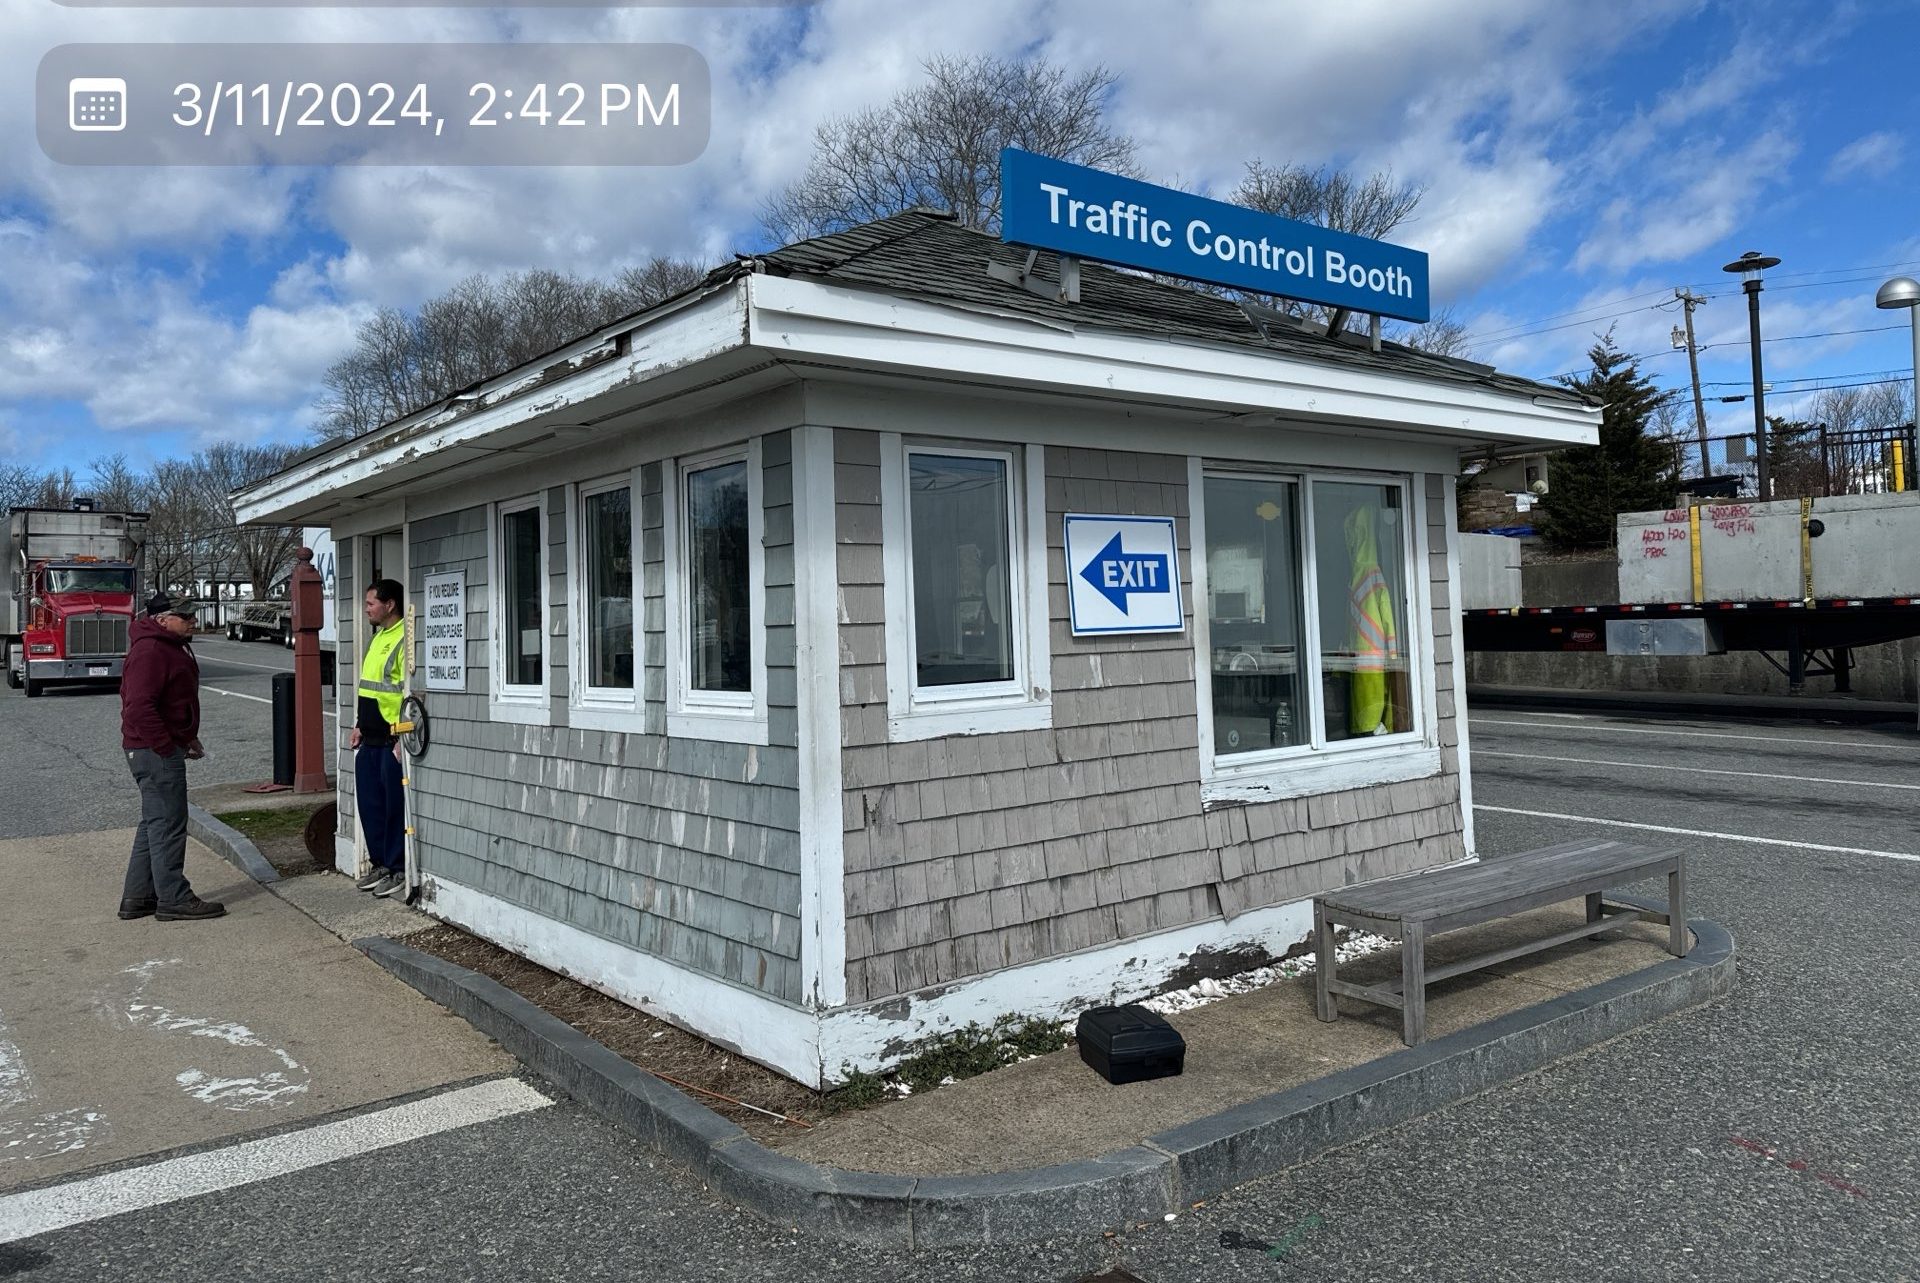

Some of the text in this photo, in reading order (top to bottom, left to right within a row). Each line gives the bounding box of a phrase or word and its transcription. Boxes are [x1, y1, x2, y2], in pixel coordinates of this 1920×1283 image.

[1040, 183, 1413, 298] Traffic Control Booth
[1102, 560, 1159, 588] EXIT
[433, 584, 441, 599] YOU
[441, 582, 459, 598] REQUIRE
[430, 603, 459, 618] ASSISTANCE IN
[427, 623, 463, 639] BOARDING PLEASE
[440, 645, 448, 659] FOR
[449, 645, 457, 659] THE
[428, 665, 461, 680] TERMINAL AGENT
